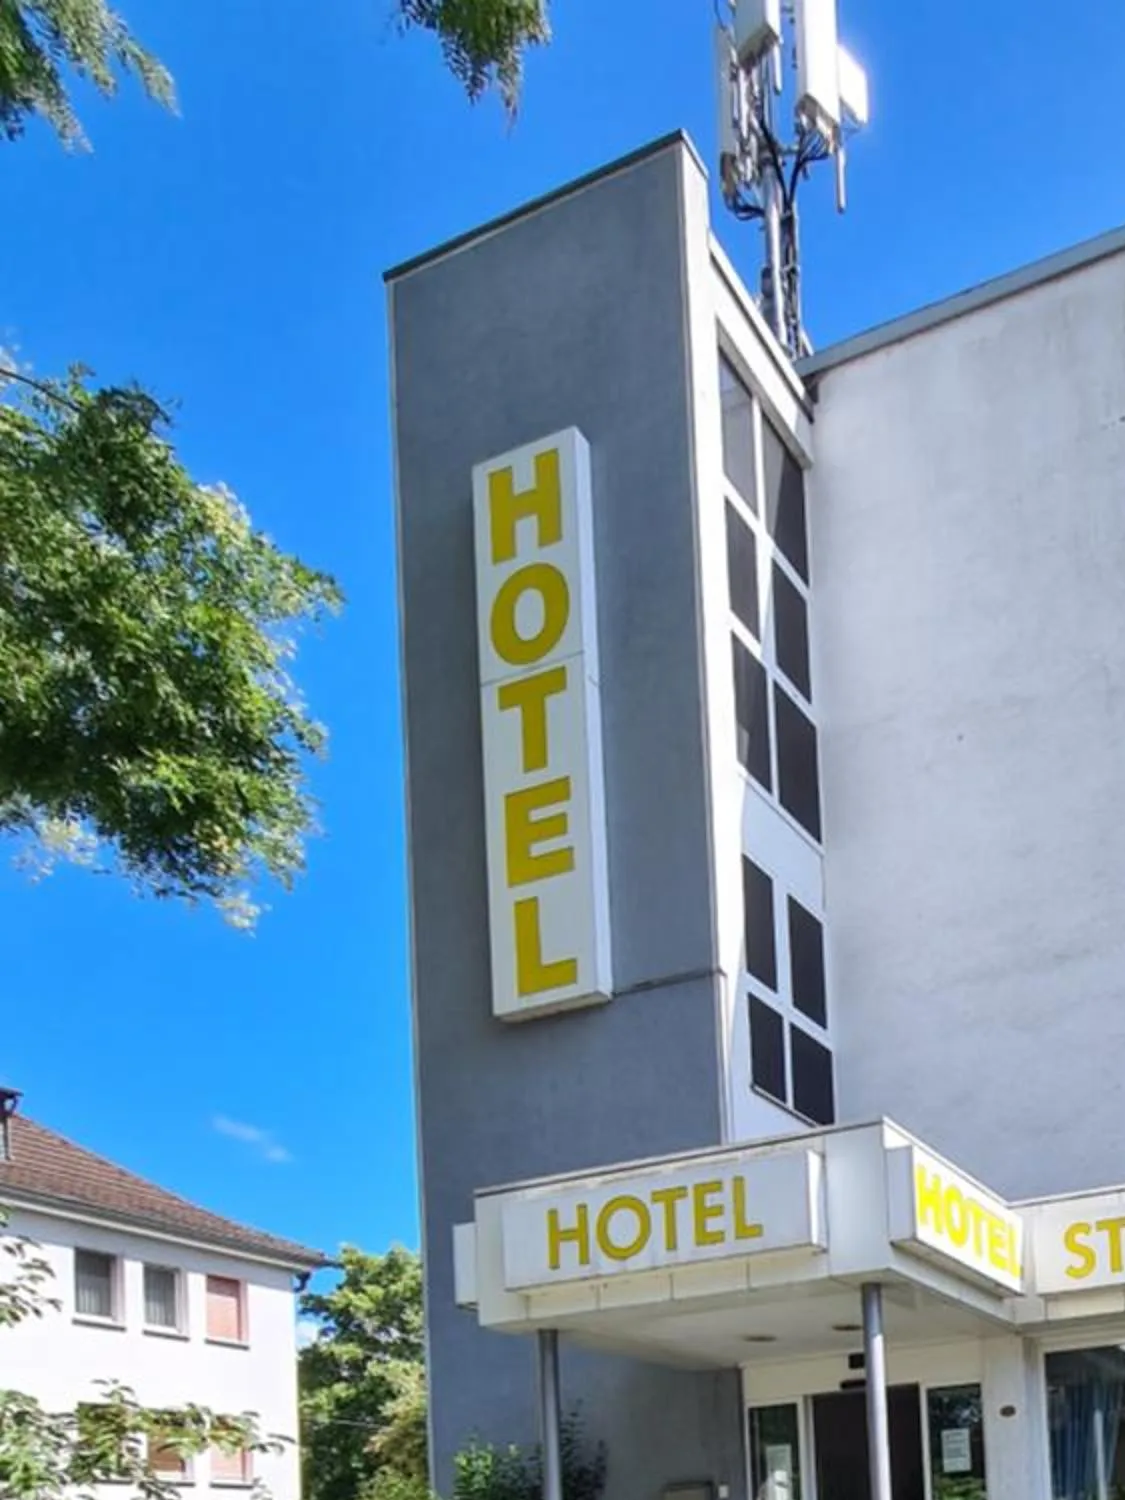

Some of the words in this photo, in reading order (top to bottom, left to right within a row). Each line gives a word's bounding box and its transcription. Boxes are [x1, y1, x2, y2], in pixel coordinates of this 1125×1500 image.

[488, 447, 577, 997] HOTEL
[547, 1176, 763, 1270] HOTEL
[915, 1163, 1022, 1277] HOTEL
